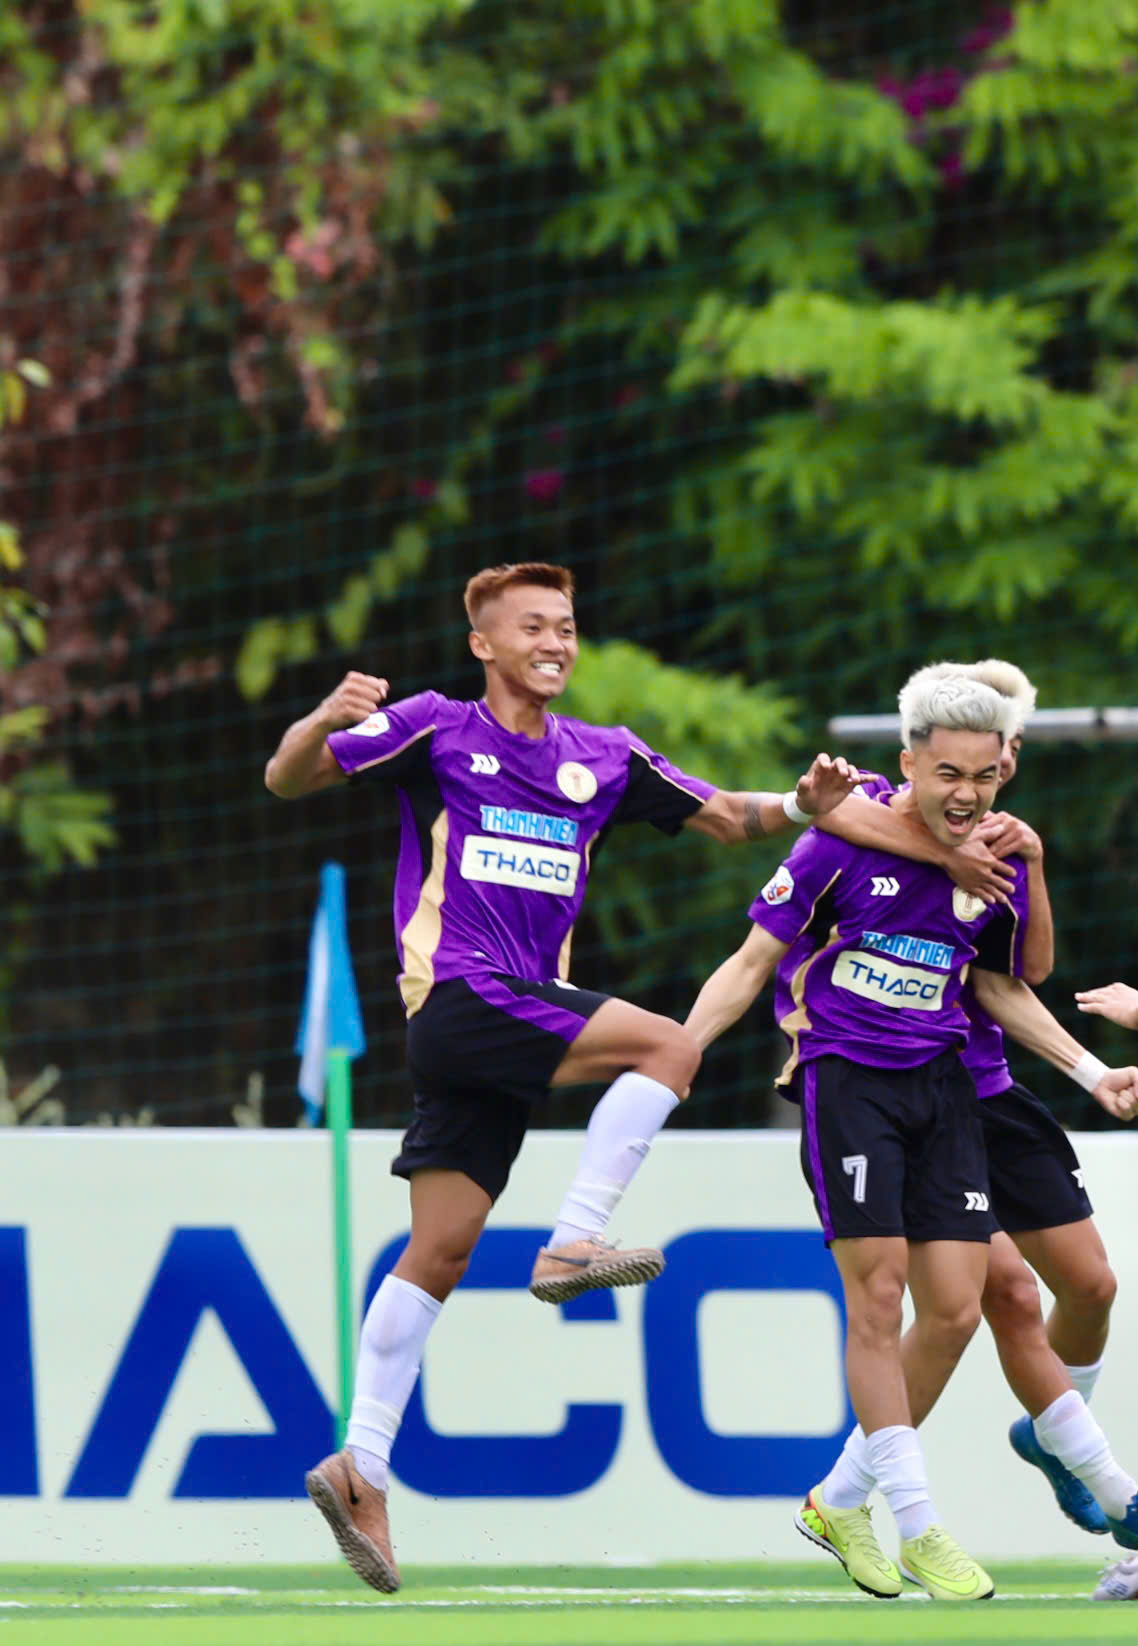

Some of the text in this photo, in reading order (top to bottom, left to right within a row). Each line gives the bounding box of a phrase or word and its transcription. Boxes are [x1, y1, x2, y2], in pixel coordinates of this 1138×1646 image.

[477, 849, 570, 882] THACO
[848, 960, 939, 1000] THACO
[841, 1154, 868, 1203] 7
[0, 1226, 850, 1498] ACO
